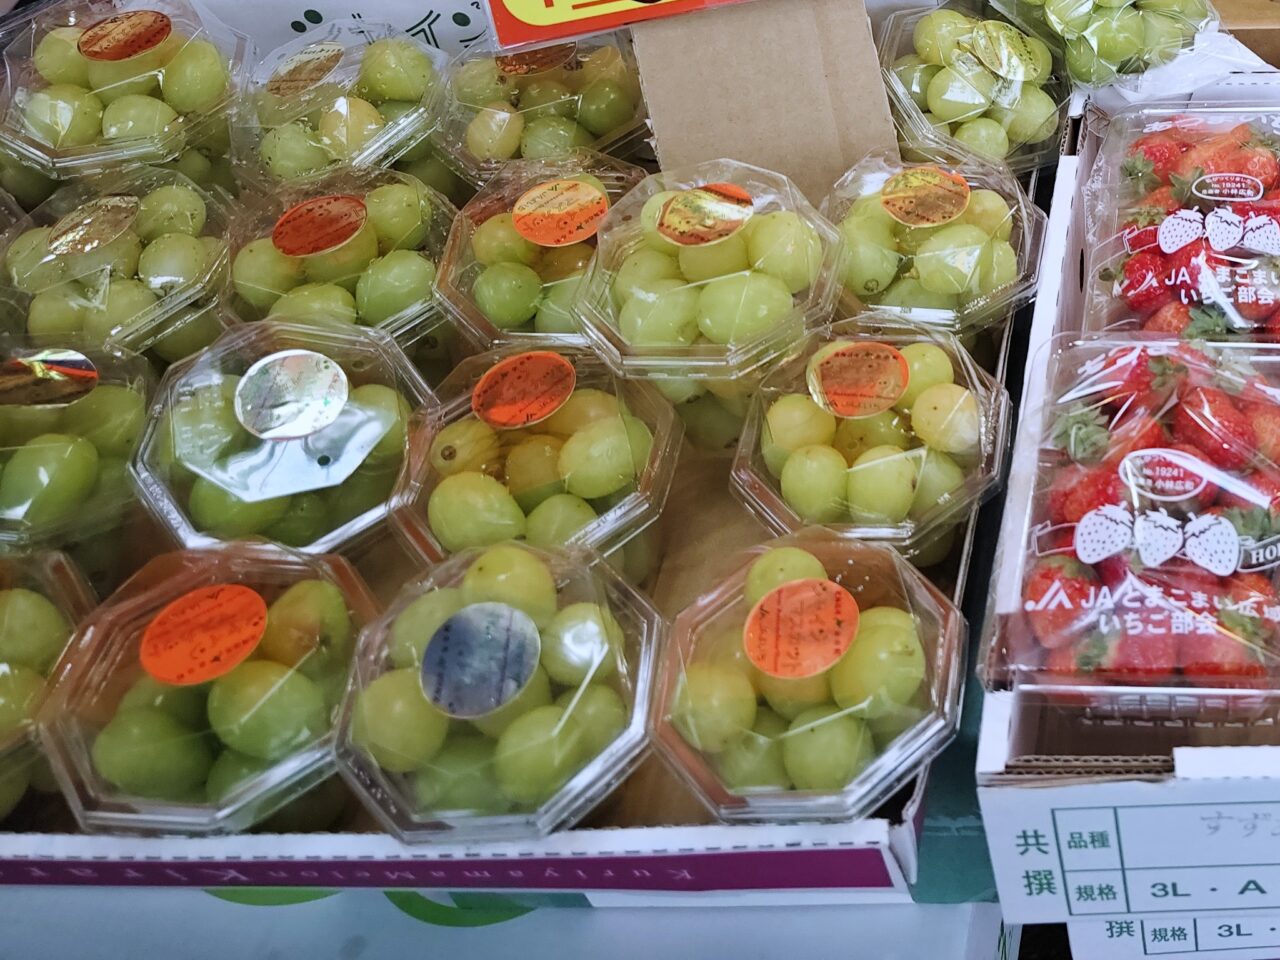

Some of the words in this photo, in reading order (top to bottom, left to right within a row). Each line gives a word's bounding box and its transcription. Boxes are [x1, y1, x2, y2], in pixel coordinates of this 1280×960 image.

[1100, 610, 1217, 636] いちご部会
[1067, 830, 1111, 850] 品種
[1075, 882, 1118, 903] 規格
[1151, 925, 1189, 944] 規格
